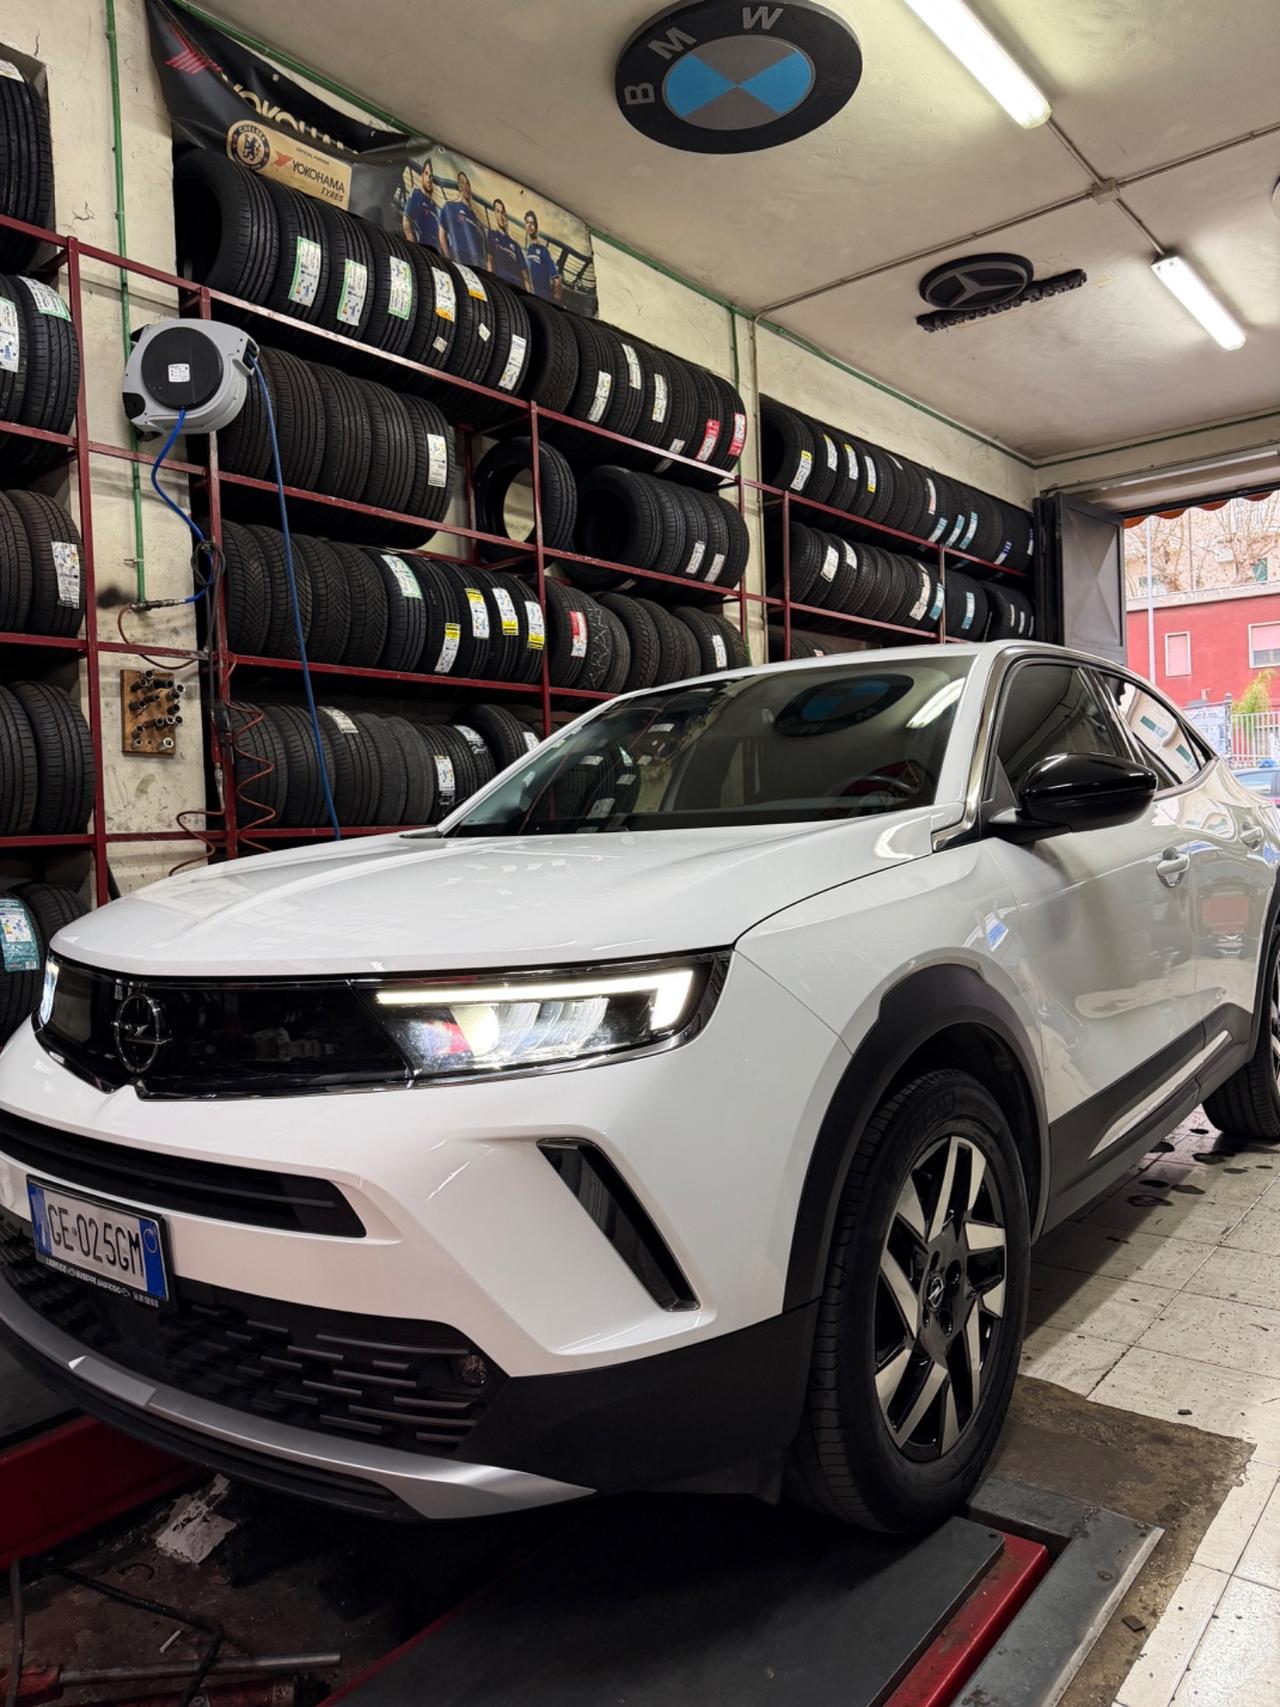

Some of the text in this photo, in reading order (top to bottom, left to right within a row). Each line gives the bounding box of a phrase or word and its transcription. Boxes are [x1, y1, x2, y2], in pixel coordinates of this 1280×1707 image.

[624, 6, 784, 105] BMW
[292, 160, 345, 193] YOKOHAMA
[320, 187, 344, 202] TYRES
